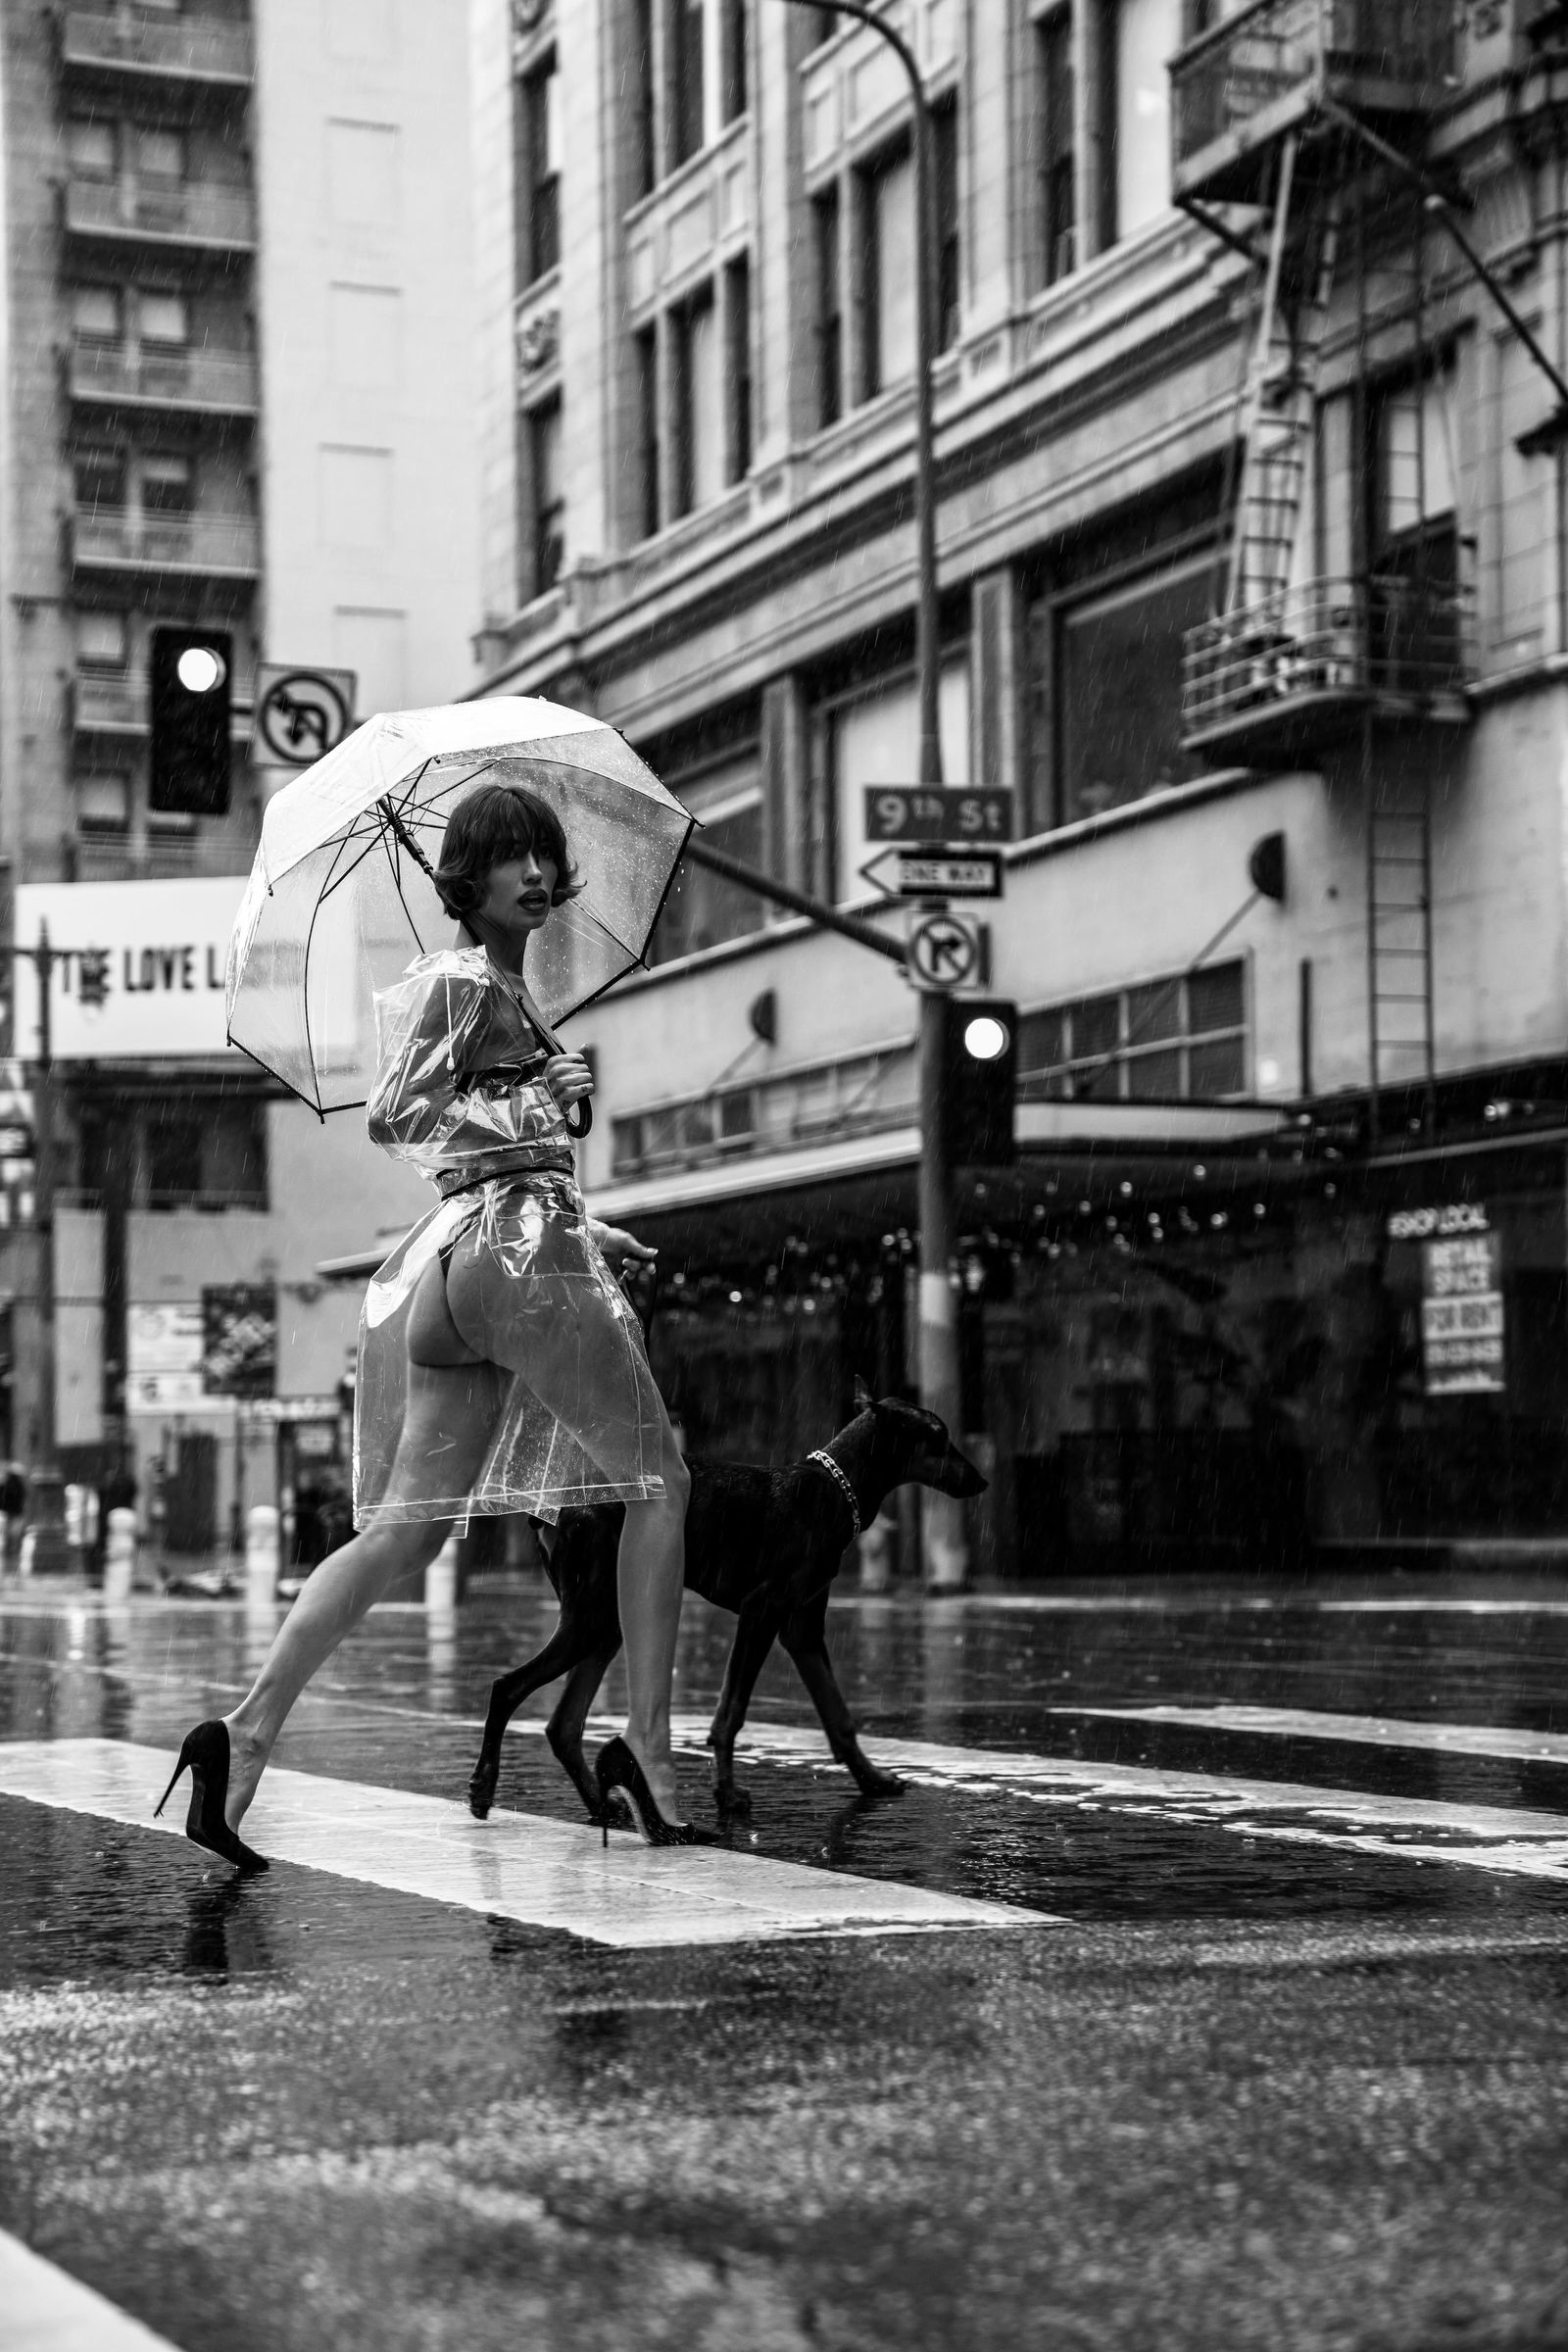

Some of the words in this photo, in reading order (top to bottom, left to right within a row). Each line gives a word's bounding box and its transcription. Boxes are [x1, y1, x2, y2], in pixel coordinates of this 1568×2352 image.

[877, 794, 945, 833] 9th
[958, 797, 1001, 832] St
[901, 859, 939, 882] ONE
[946, 859, 986, 882] WAY
[123, 945, 195, 992] LOVE
